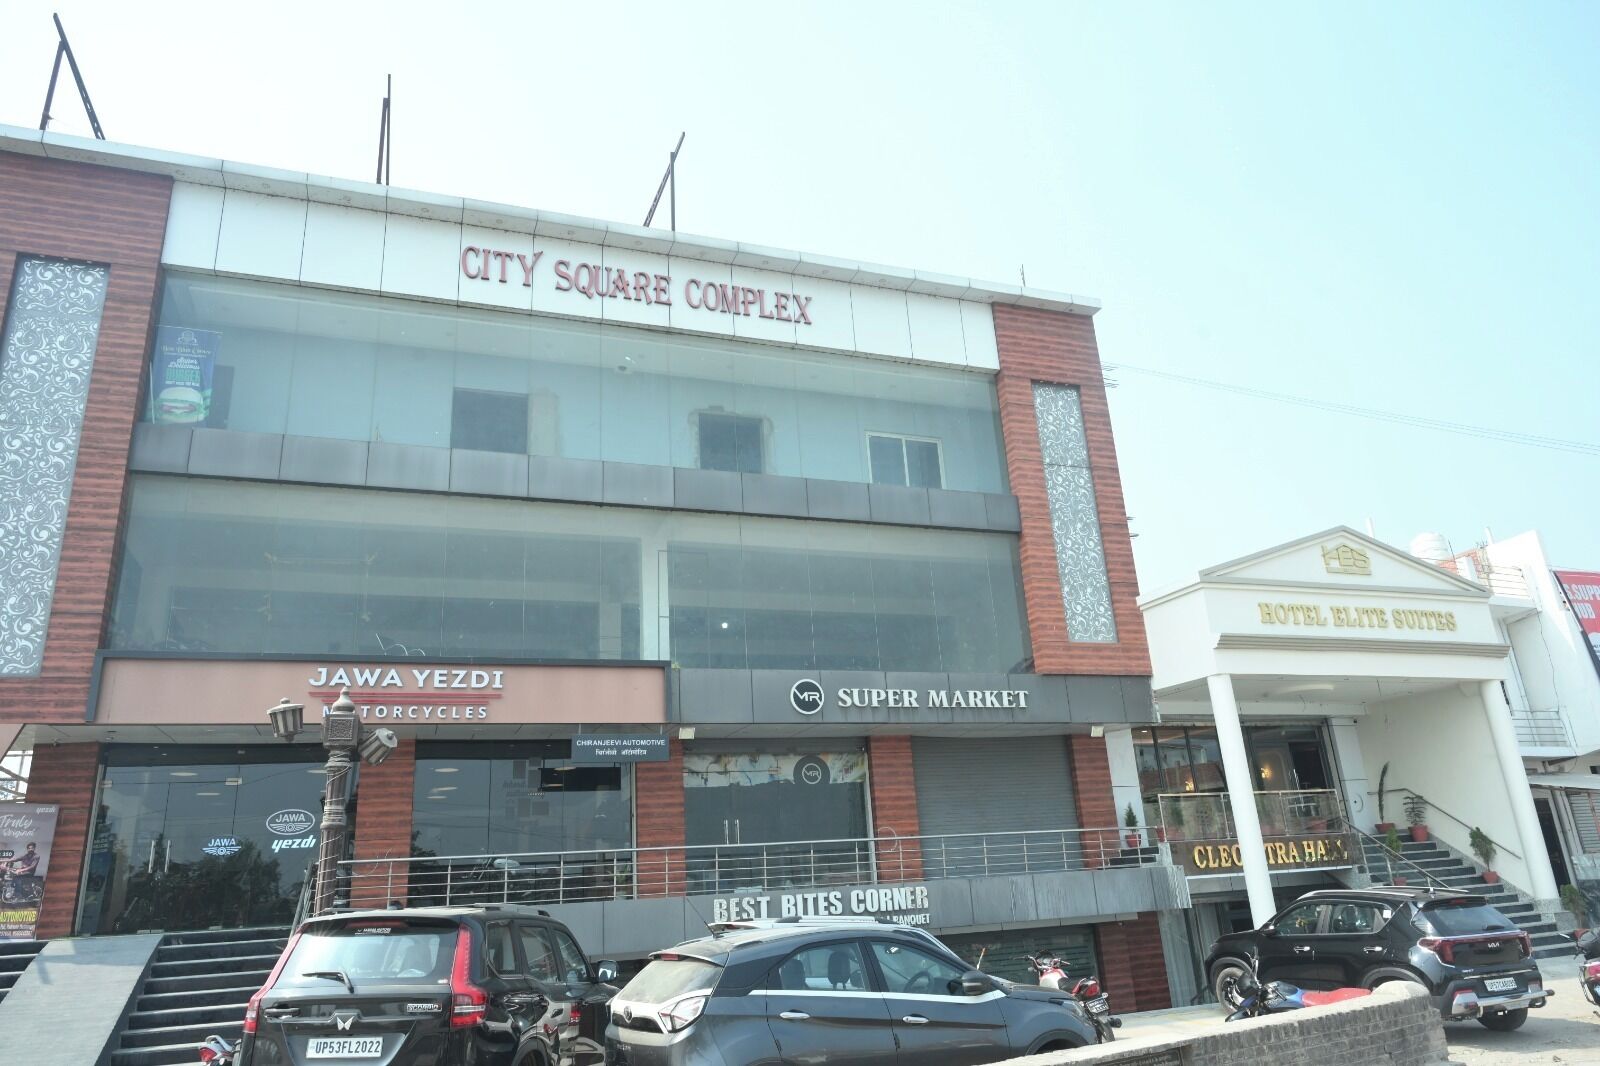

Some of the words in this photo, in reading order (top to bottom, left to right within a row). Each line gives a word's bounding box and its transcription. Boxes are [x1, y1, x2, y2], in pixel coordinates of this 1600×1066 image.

[461, 246, 543, 287] CITY
[554, 259, 672, 305] SQUARE
[685, 278, 813, 325] COMPLEX
[1258, 602, 1327, 625] HOTEL
[1330, 605, 1389, 628] ELITE
[1391, 608, 1457, 631] SUITES
[308, 667, 404, 687] JAWA
[412, 669, 504, 689] YEZDI
[837, 688, 919, 708] SUPER
[928, 689, 1029, 708] MARKET
[322, 705, 487, 719] MTORCYCLES
[275, 813, 306, 823] JAWA
[208, 838, 236, 847] JAWA
[271, 835, 316, 853] yezdi
[1194, 841, 1301, 869] CLEOTRA
[713, 896, 770, 923] BEST
[781, 891, 842, 918] BITES
[850, 887, 929, 913] CORNER
[893, 913, 930, 926] BANQUET
[315, 1040, 381, 1055] UP53FL2022
